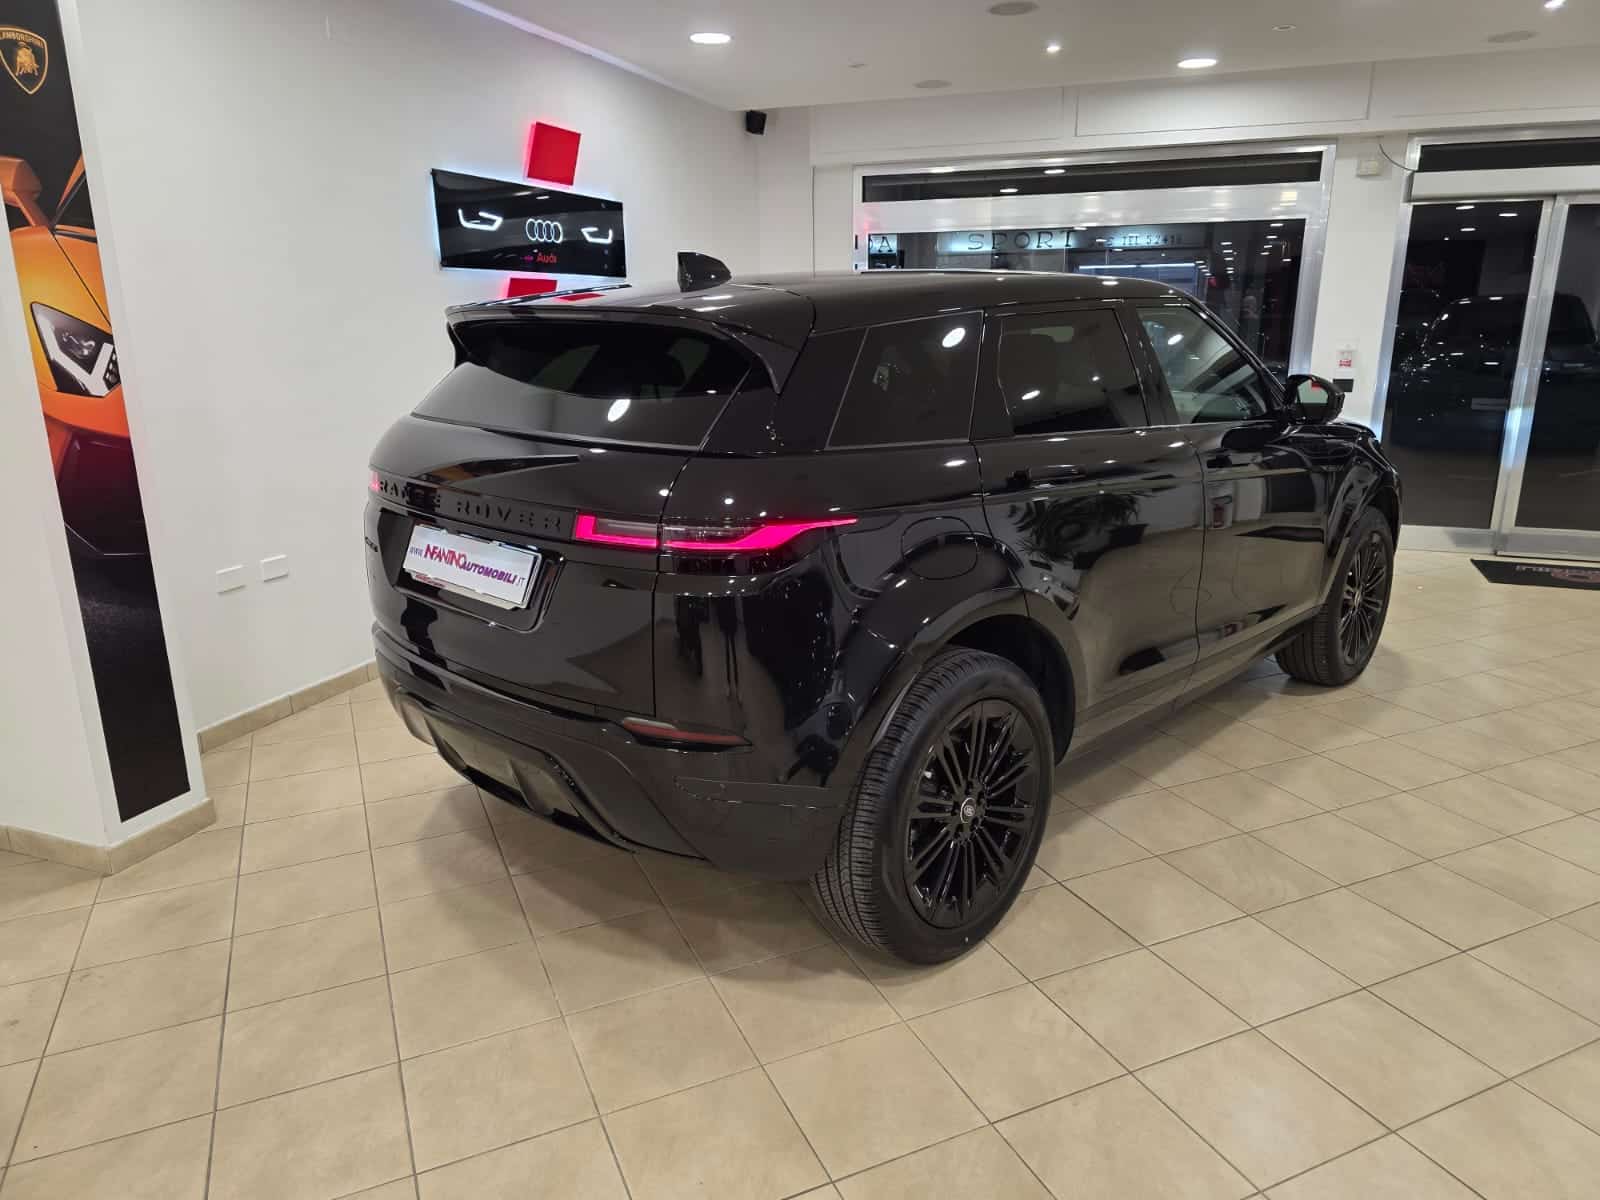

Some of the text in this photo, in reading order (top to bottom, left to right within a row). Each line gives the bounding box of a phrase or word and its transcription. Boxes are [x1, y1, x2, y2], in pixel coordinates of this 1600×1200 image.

[967, 230, 1077, 250] SPORT
[536, 252, 557, 264] Audi
[456, 500, 562, 532] ROVER
